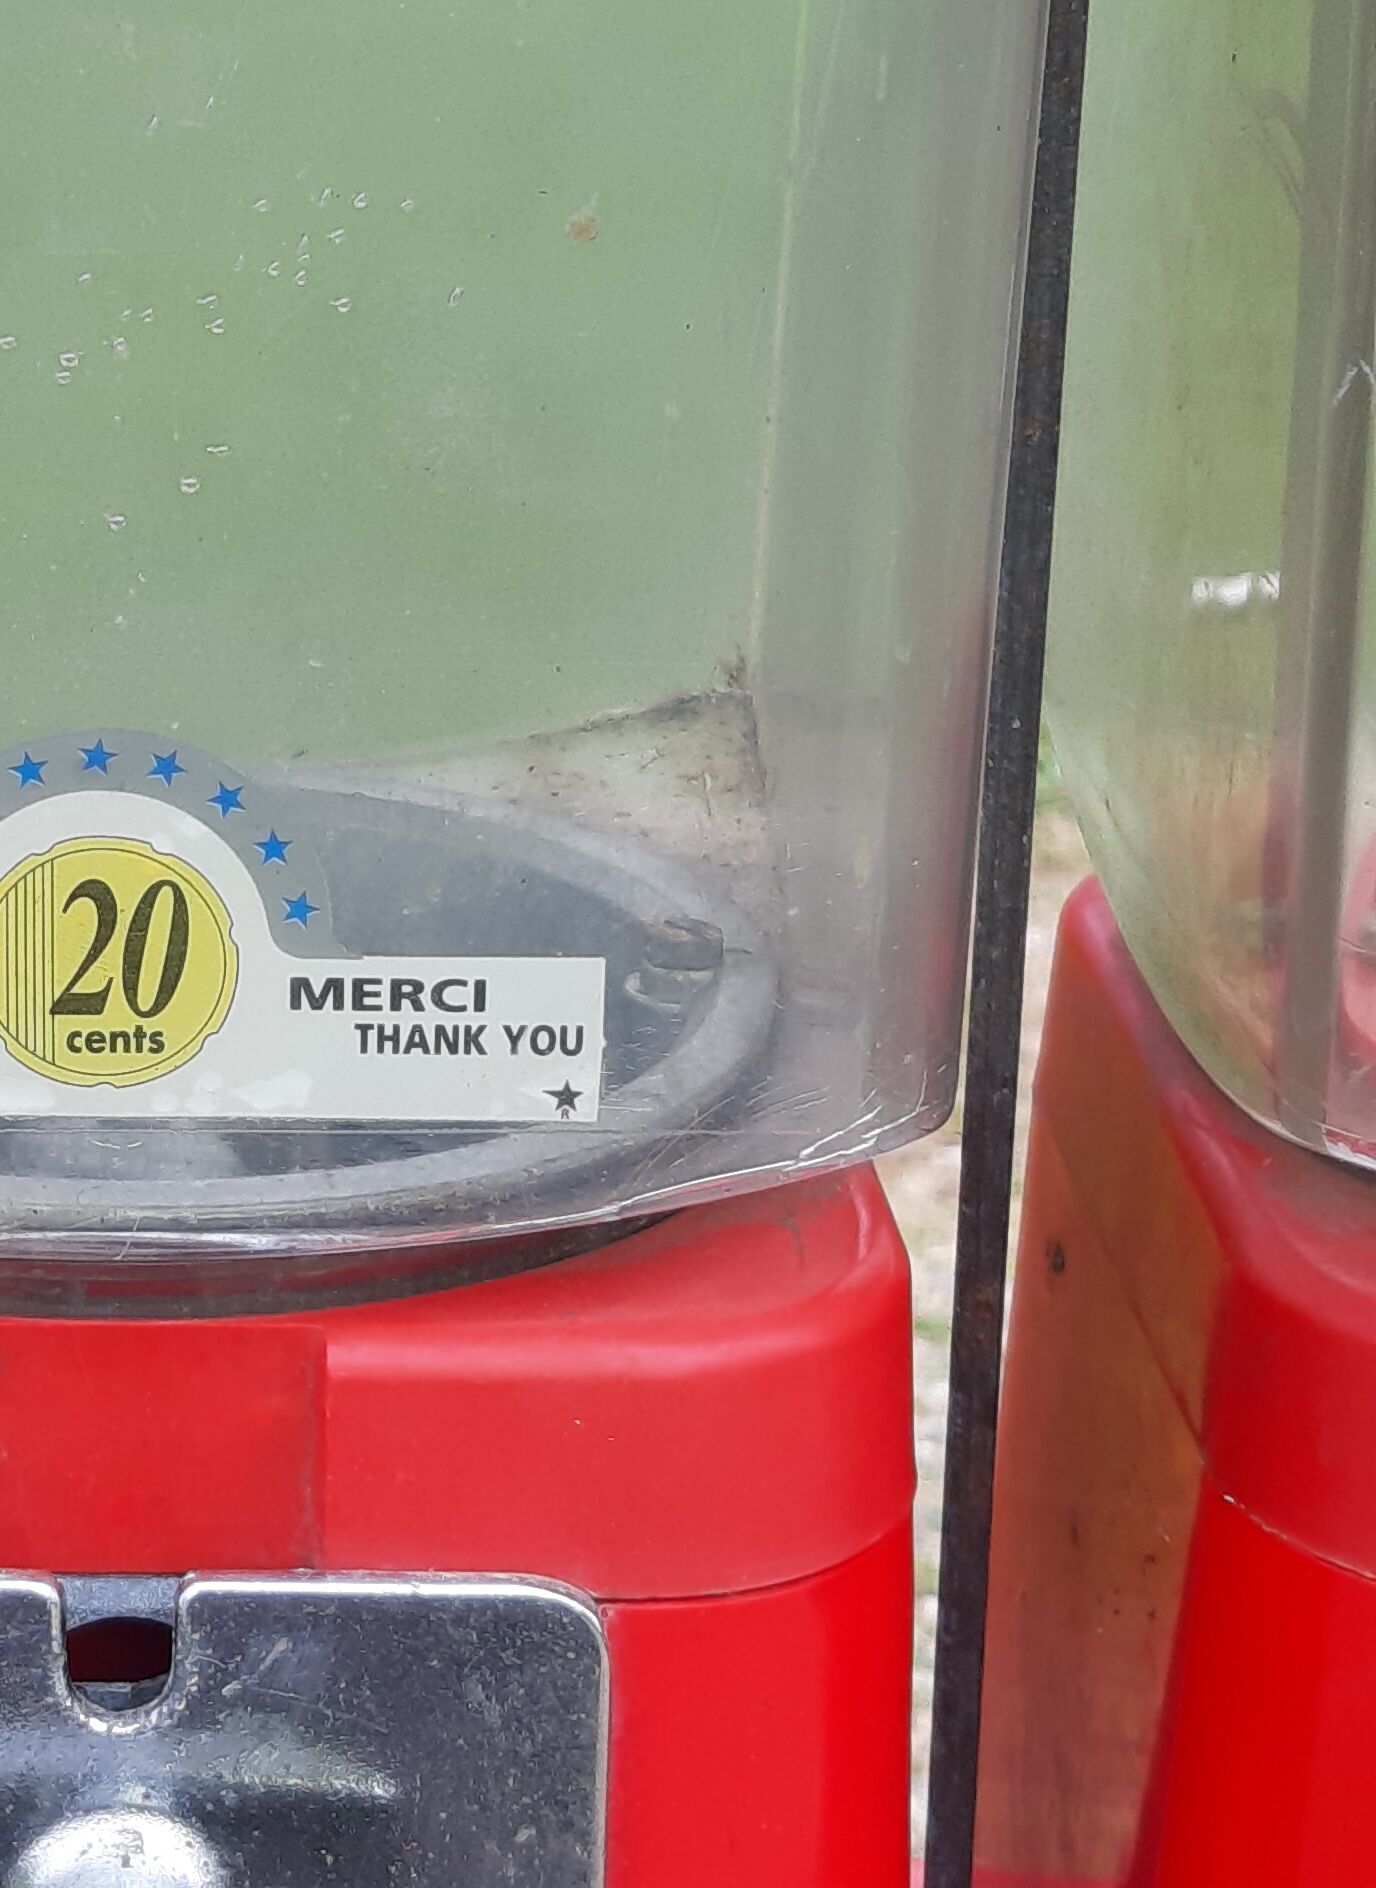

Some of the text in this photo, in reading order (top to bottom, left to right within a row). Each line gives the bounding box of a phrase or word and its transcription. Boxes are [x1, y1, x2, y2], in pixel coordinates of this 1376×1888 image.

[49, 878, 190, 1019] 20
[289, 976, 487, 1013] MERCI
[65, 1024, 166, 1054] cents
[354, 1023, 584, 1057] THANK YOU
